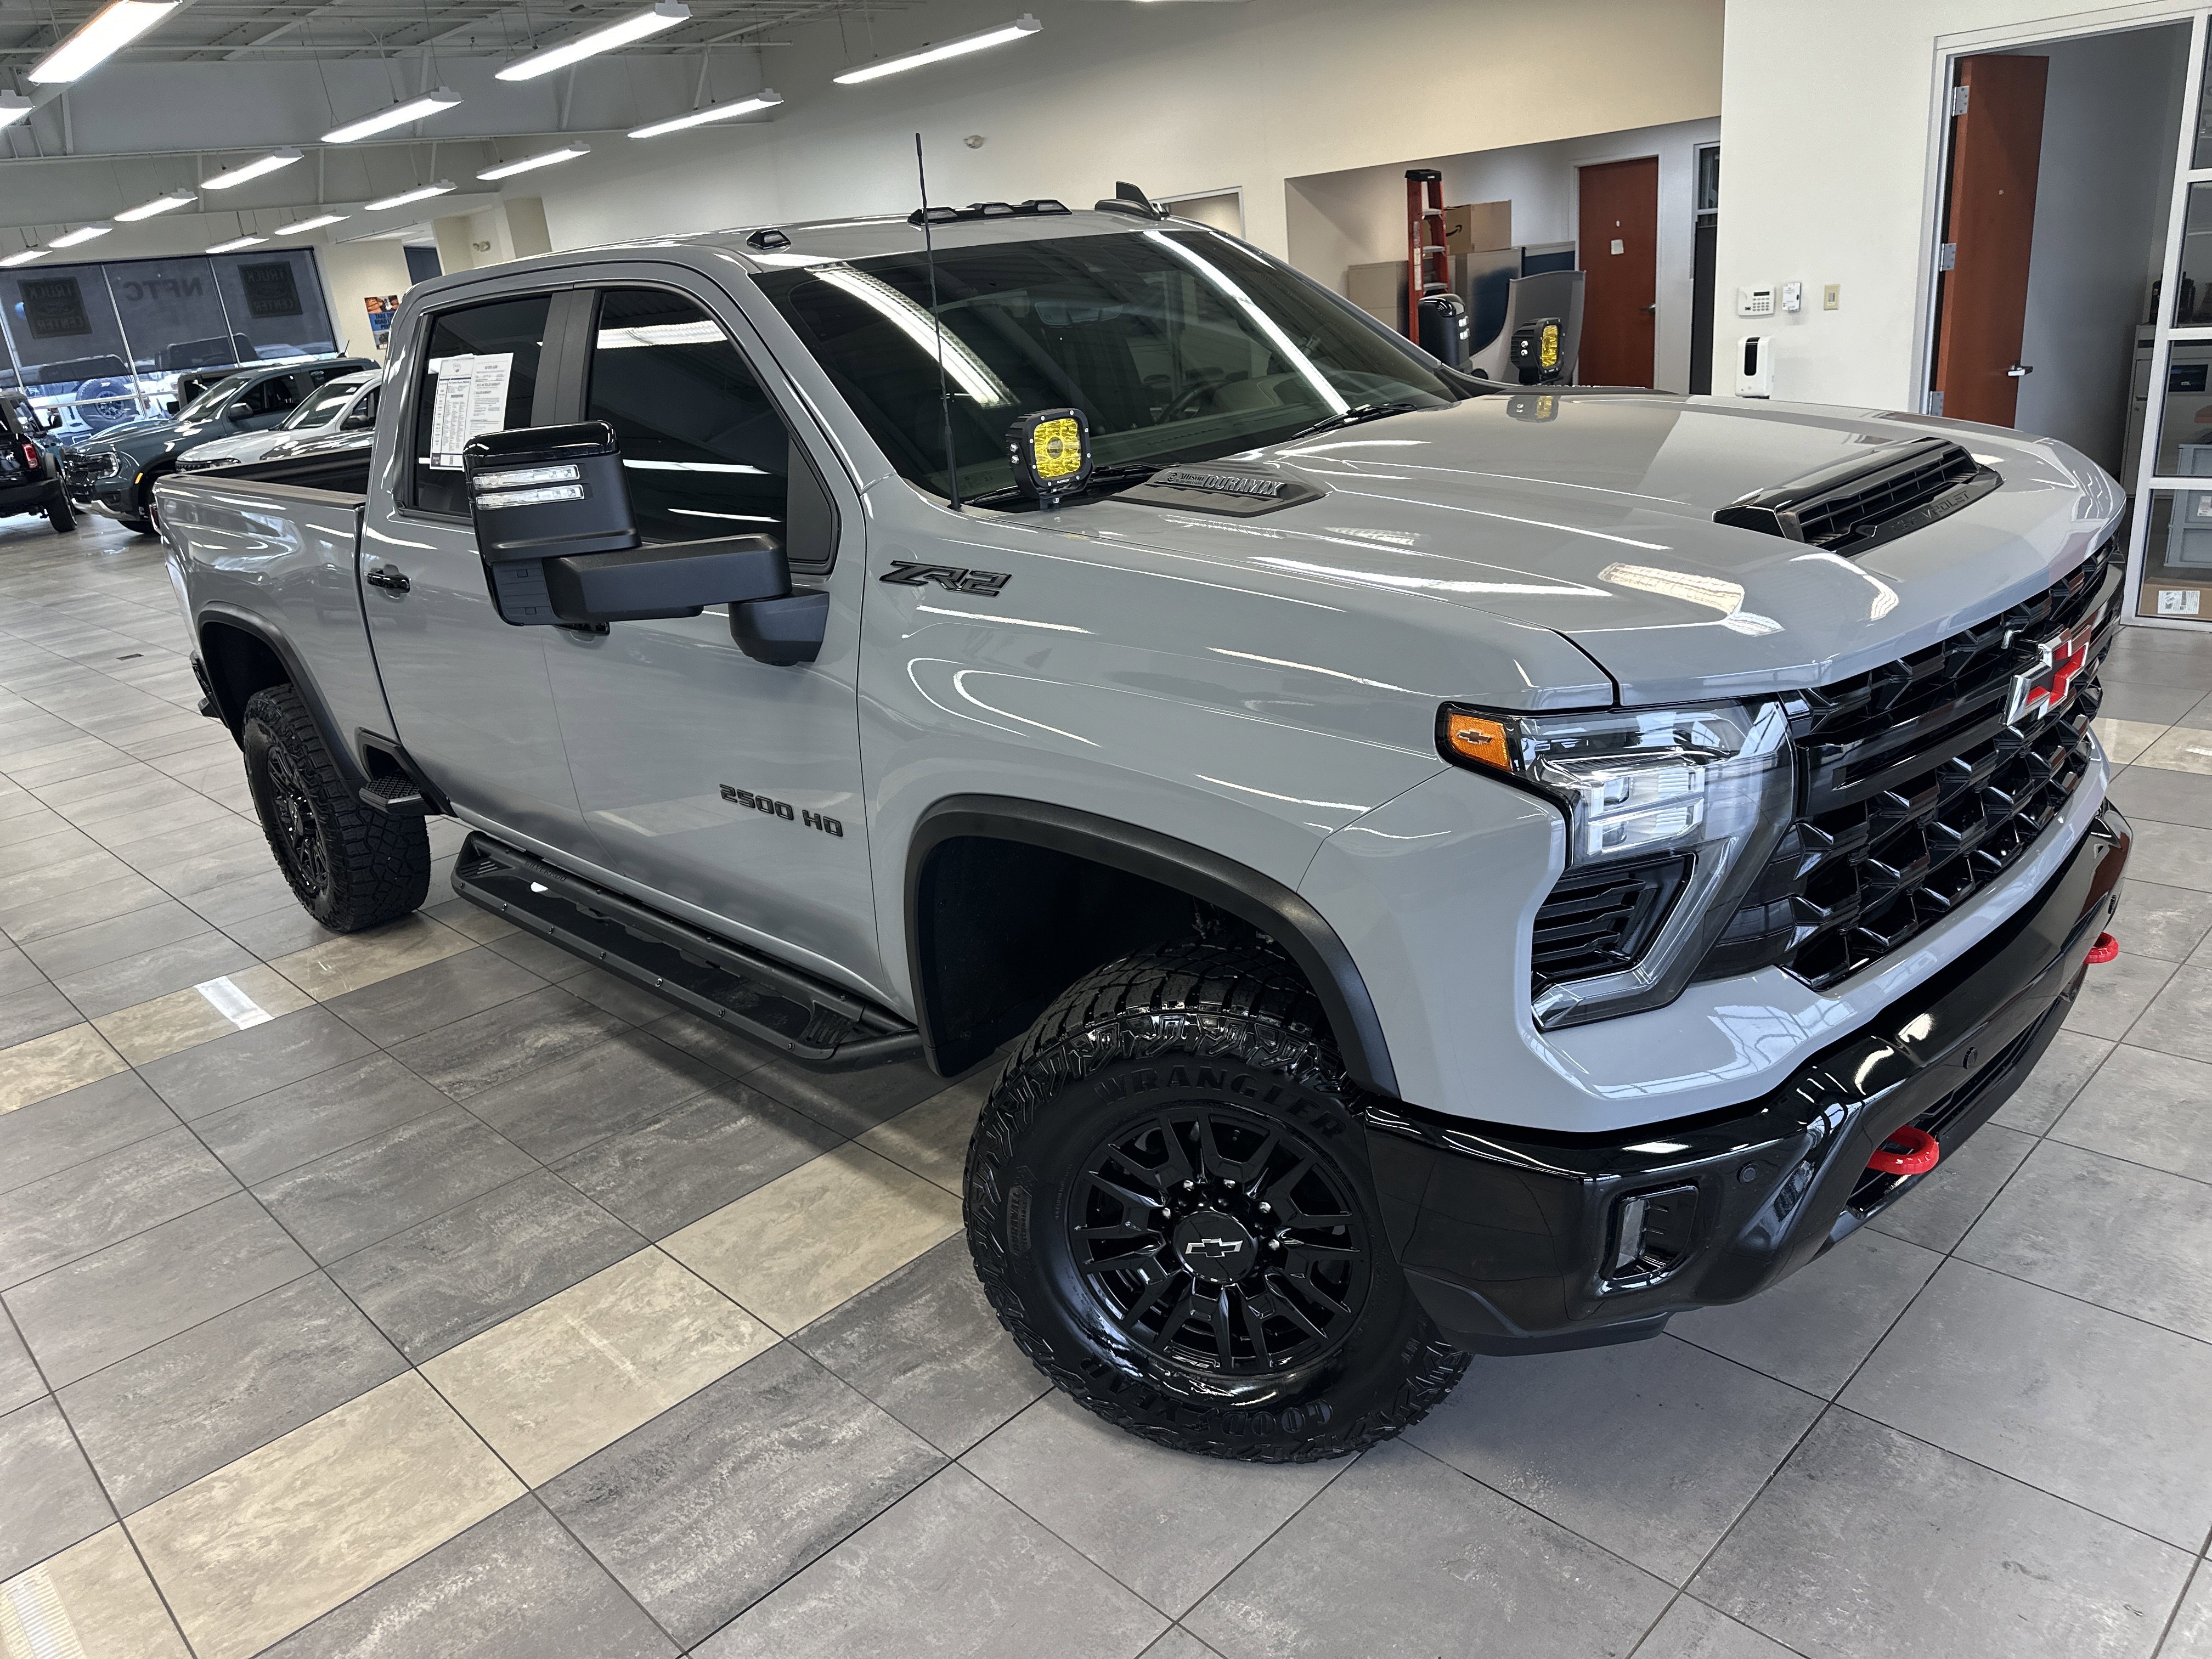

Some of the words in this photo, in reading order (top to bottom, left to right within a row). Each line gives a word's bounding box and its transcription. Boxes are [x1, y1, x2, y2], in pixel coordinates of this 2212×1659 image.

[1180, 473, 1205, 482] Allison
[1204, 474, 1284, 497] DURAMAX
[879, 560, 1012, 597] ZR2
[719, 783, 794, 821] 2500
[802, 809, 843, 837] HD
[1093, 1064, 1346, 1139] WRANGLER
[1080, 1354, 1334, 1436] GOODYEAR
